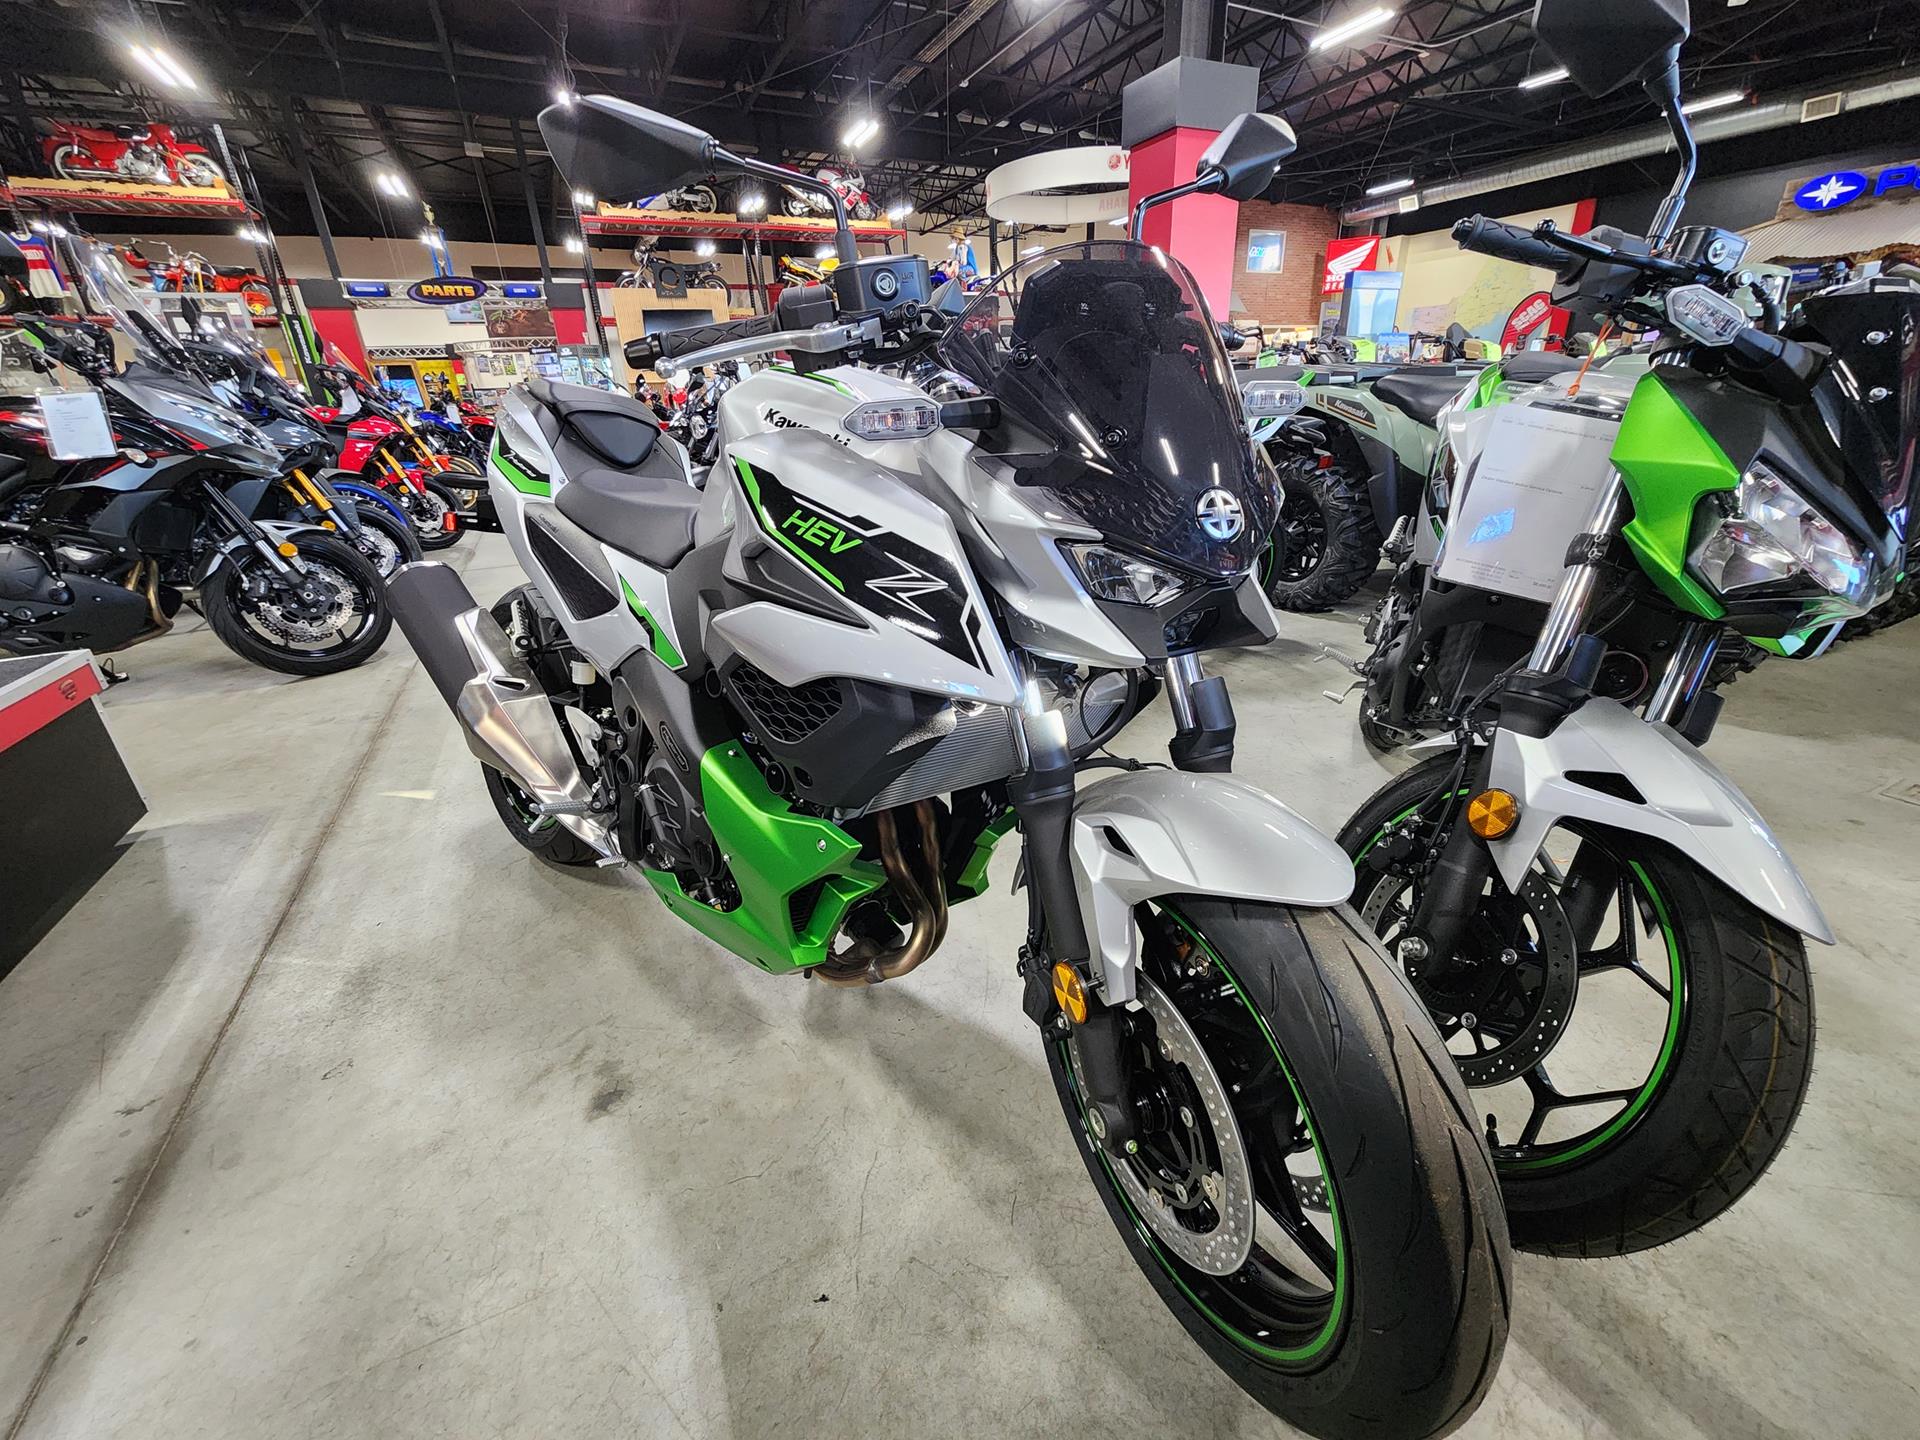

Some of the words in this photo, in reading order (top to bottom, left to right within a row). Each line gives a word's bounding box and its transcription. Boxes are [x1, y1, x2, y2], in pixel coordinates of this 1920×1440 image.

[1874, 165, 1920, 197] P
[421, 284, 475, 297] PARTS
[292, 319, 313, 364] Kawasaki
[1334, 399, 1368, 419] Kawasaki
[763, 408, 851, 446] Kawki
[782, 509, 864, 554] HEV
